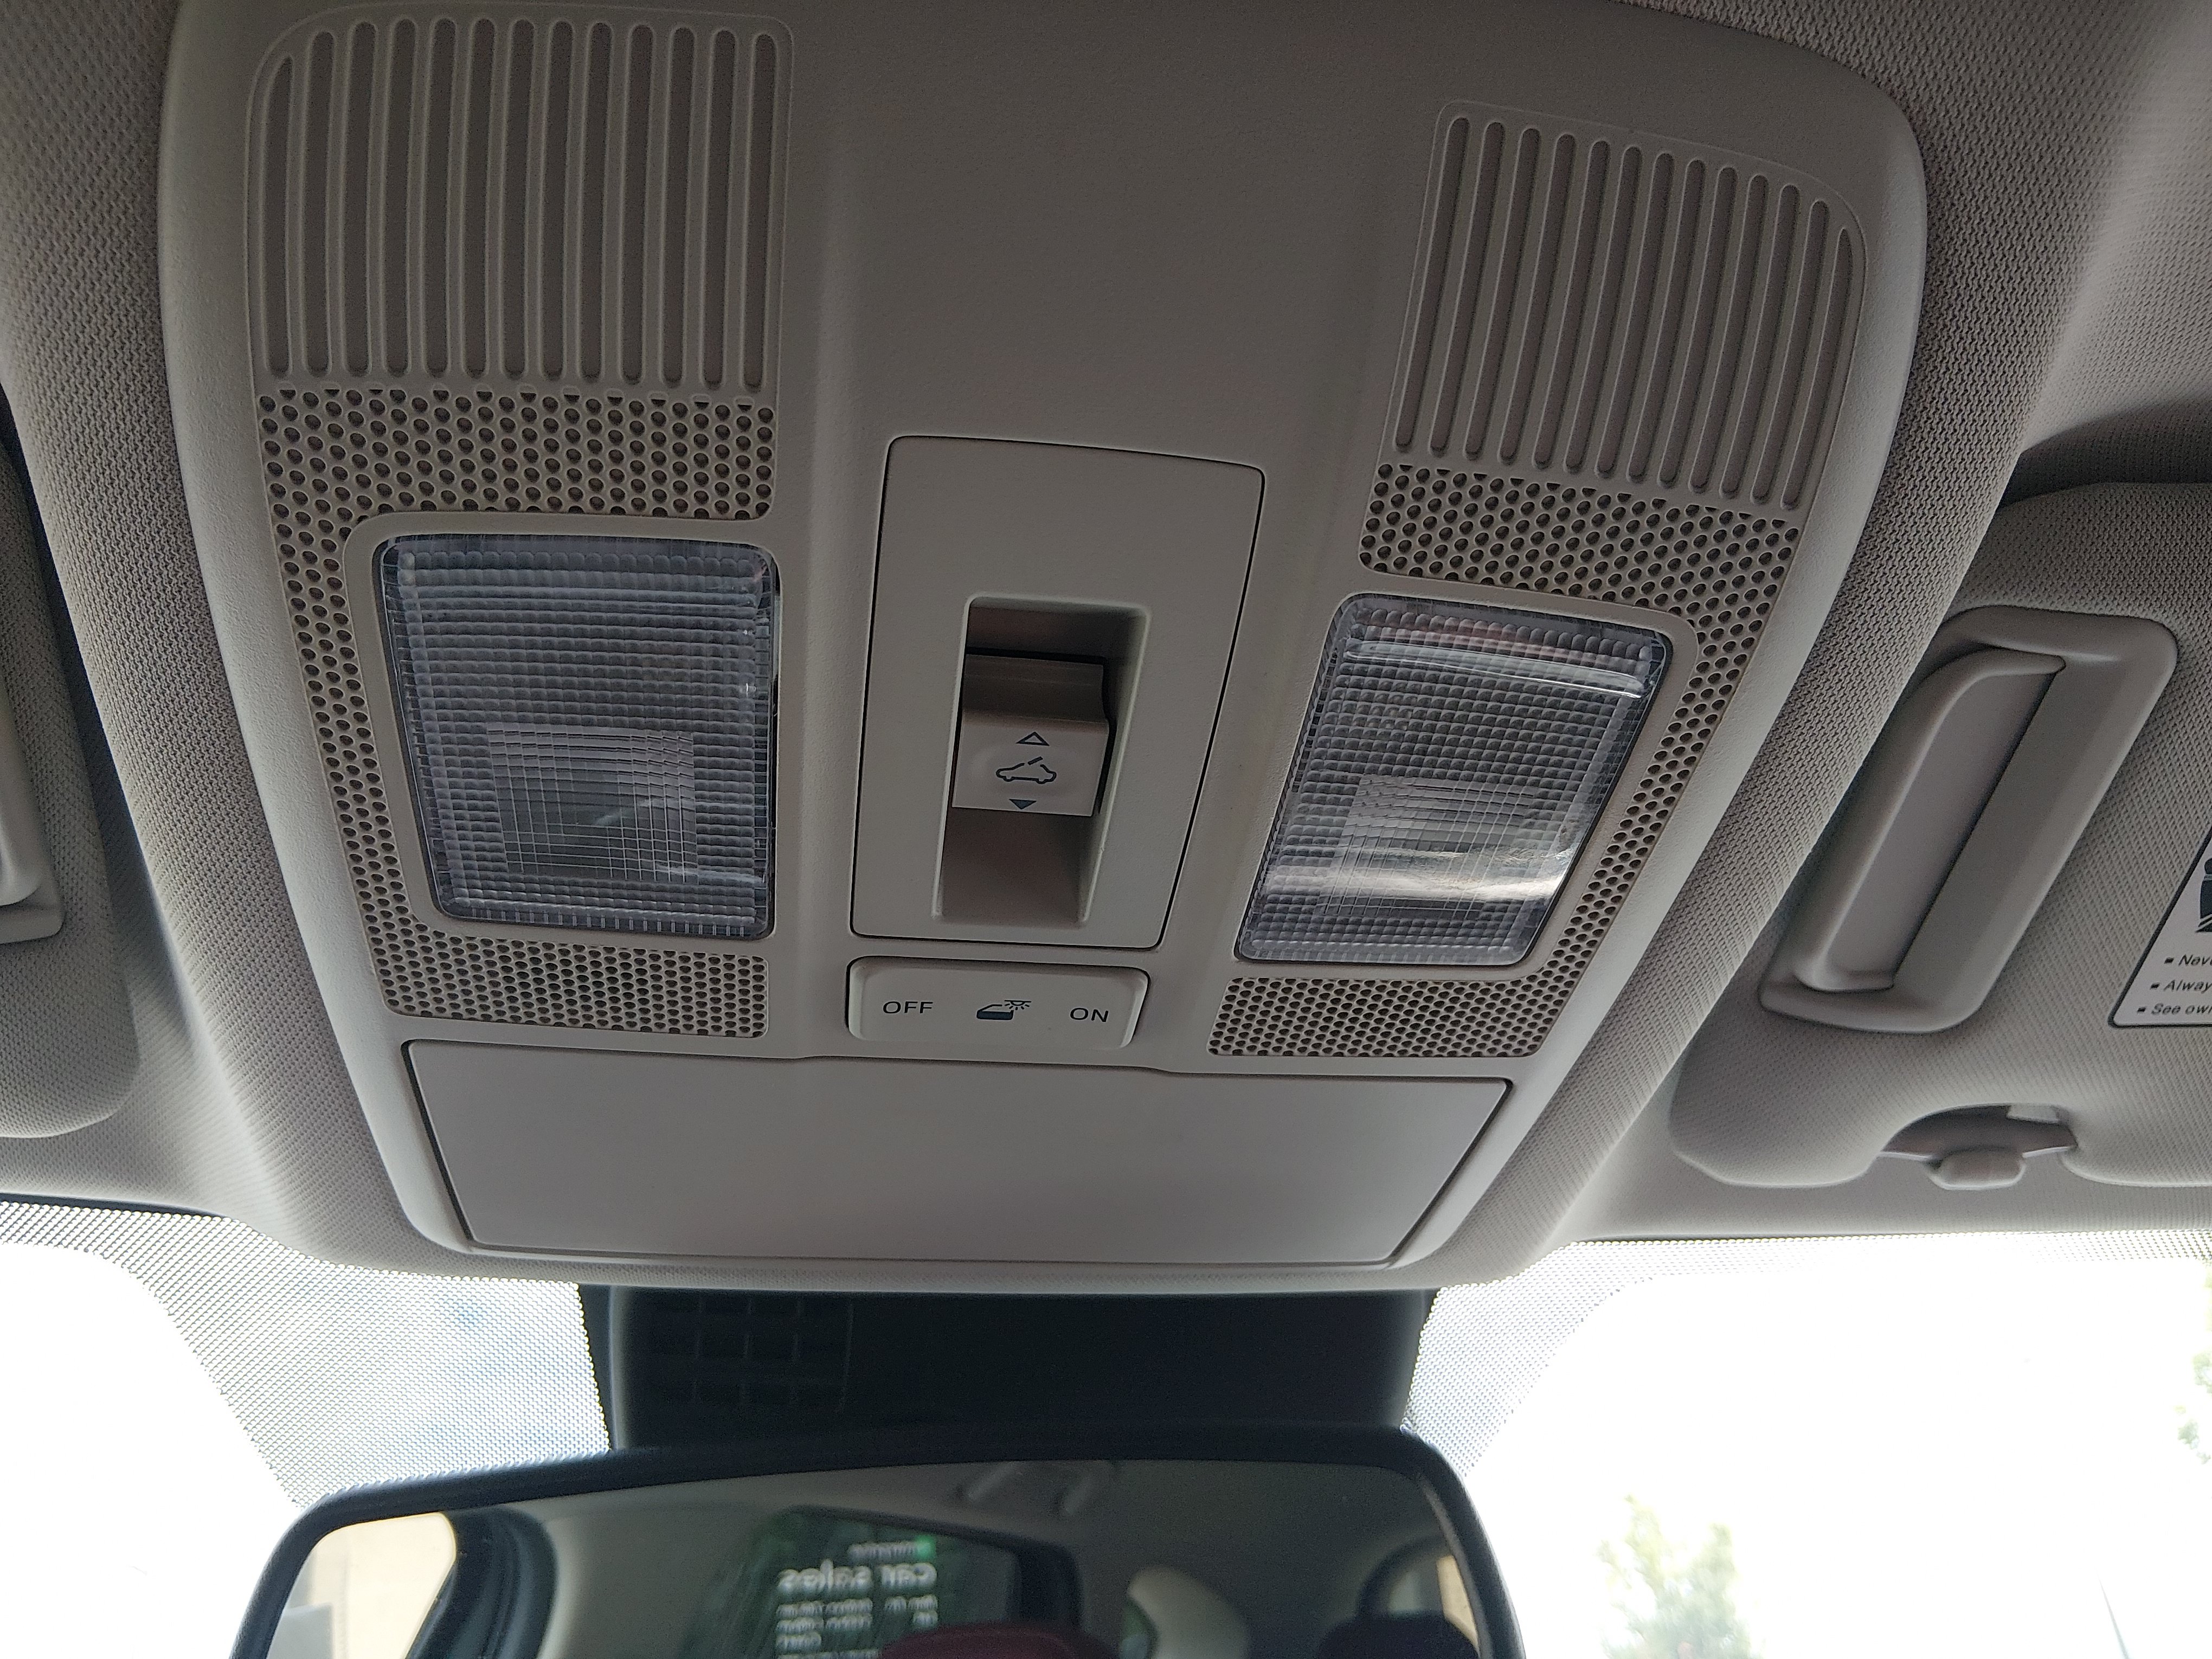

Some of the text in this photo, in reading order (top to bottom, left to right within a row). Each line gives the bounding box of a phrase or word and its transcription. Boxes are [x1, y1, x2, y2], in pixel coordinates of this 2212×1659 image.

[2178, 954, 2212, 966] Nev
[883, 1001, 934, 1014] OFF
[2151, 1004, 2181, 1015] See
[1070, 1008, 1109, 1023] ON
